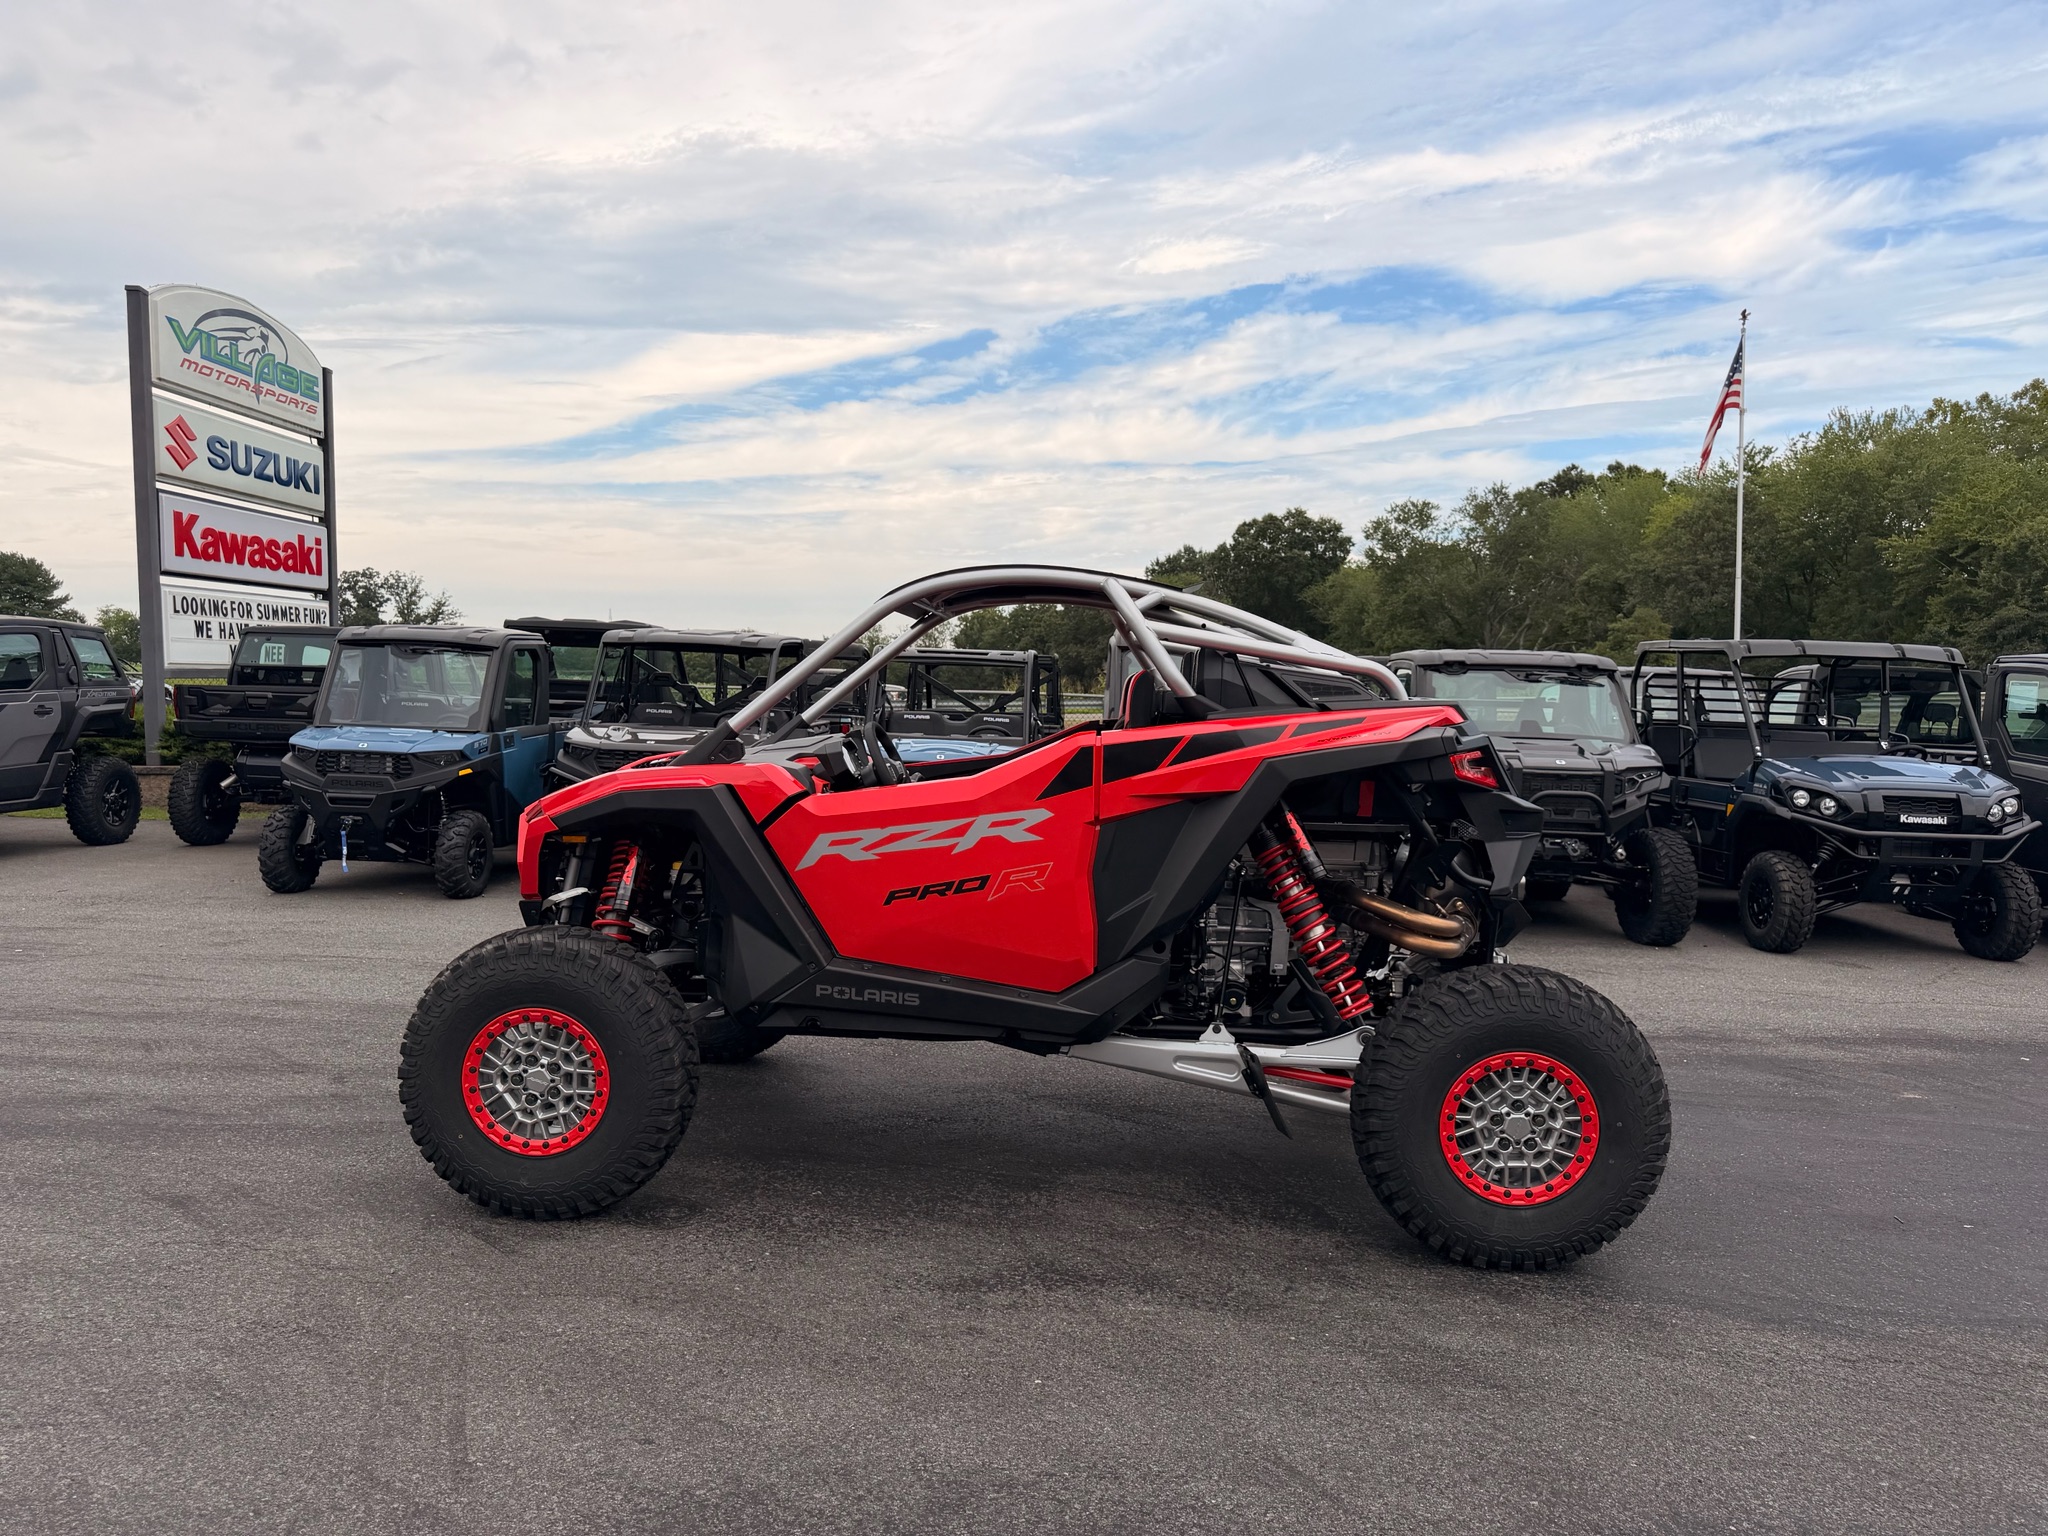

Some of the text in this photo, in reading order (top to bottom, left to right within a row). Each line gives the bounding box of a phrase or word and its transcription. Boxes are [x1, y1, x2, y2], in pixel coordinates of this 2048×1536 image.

[165, 315, 319, 403] VILLAGE
[179, 357, 318, 415] MOTORSPORTS
[206, 434, 320, 495] SUZUKI
[173, 510, 323, 576] Kawasaki
[173, 595, 327, 624] LOOKING FOR SUMMER FUN?
[194, 620, 250, 640] WE HAV
[227, 722, 289, 732] POLARIS
[332, 779, 384, 788] POLARIS
[1900, 814, 1948, 825] Kawasaki
[794, 808, 1055, 872] RZR
[882, 862, 1054, 906] PRO R
[816, 984, 920, 1006] POLARIS
